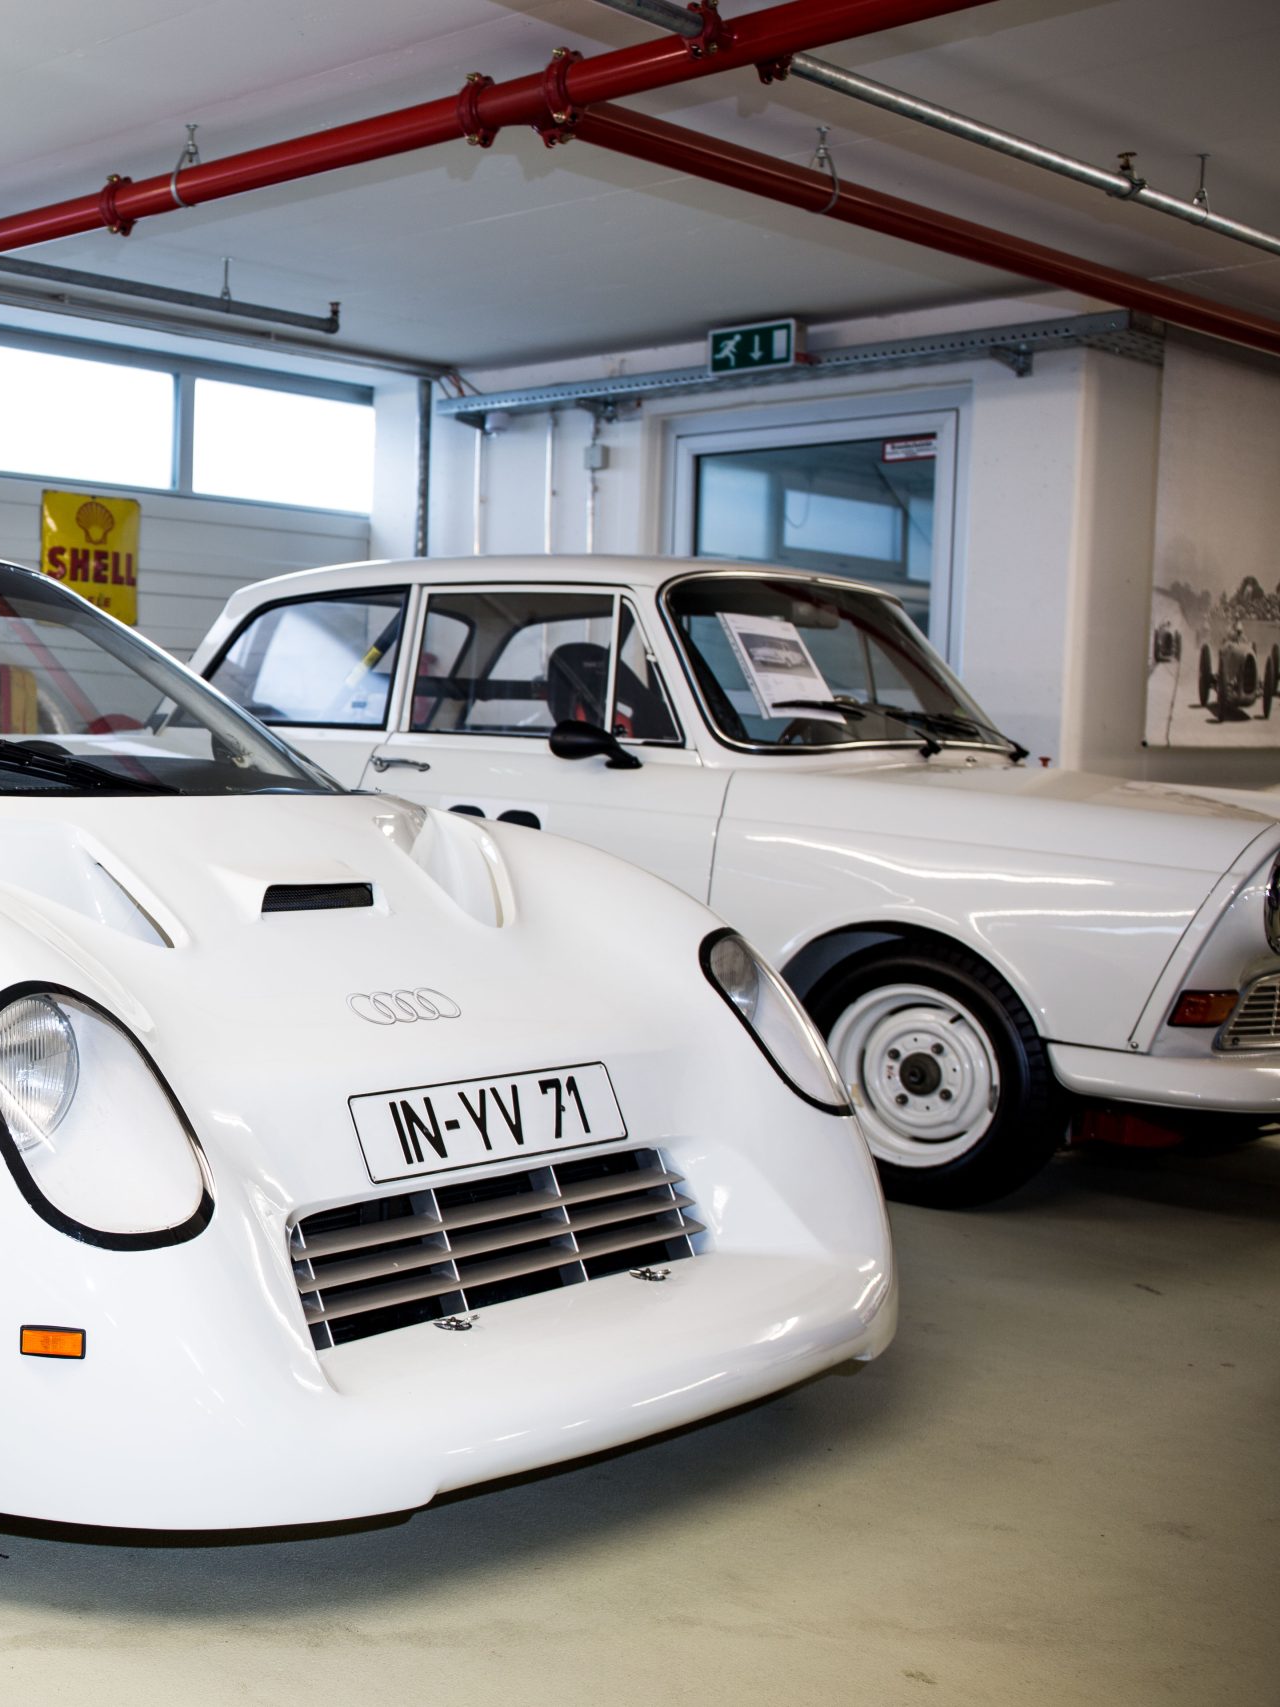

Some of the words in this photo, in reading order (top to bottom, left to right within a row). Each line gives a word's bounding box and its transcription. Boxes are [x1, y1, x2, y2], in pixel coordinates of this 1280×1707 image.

[47, 546, 136, 587] SHELL
[389, 1084, 525, 1165] IN-YV
[538, 1076, 591, 1139] 71
